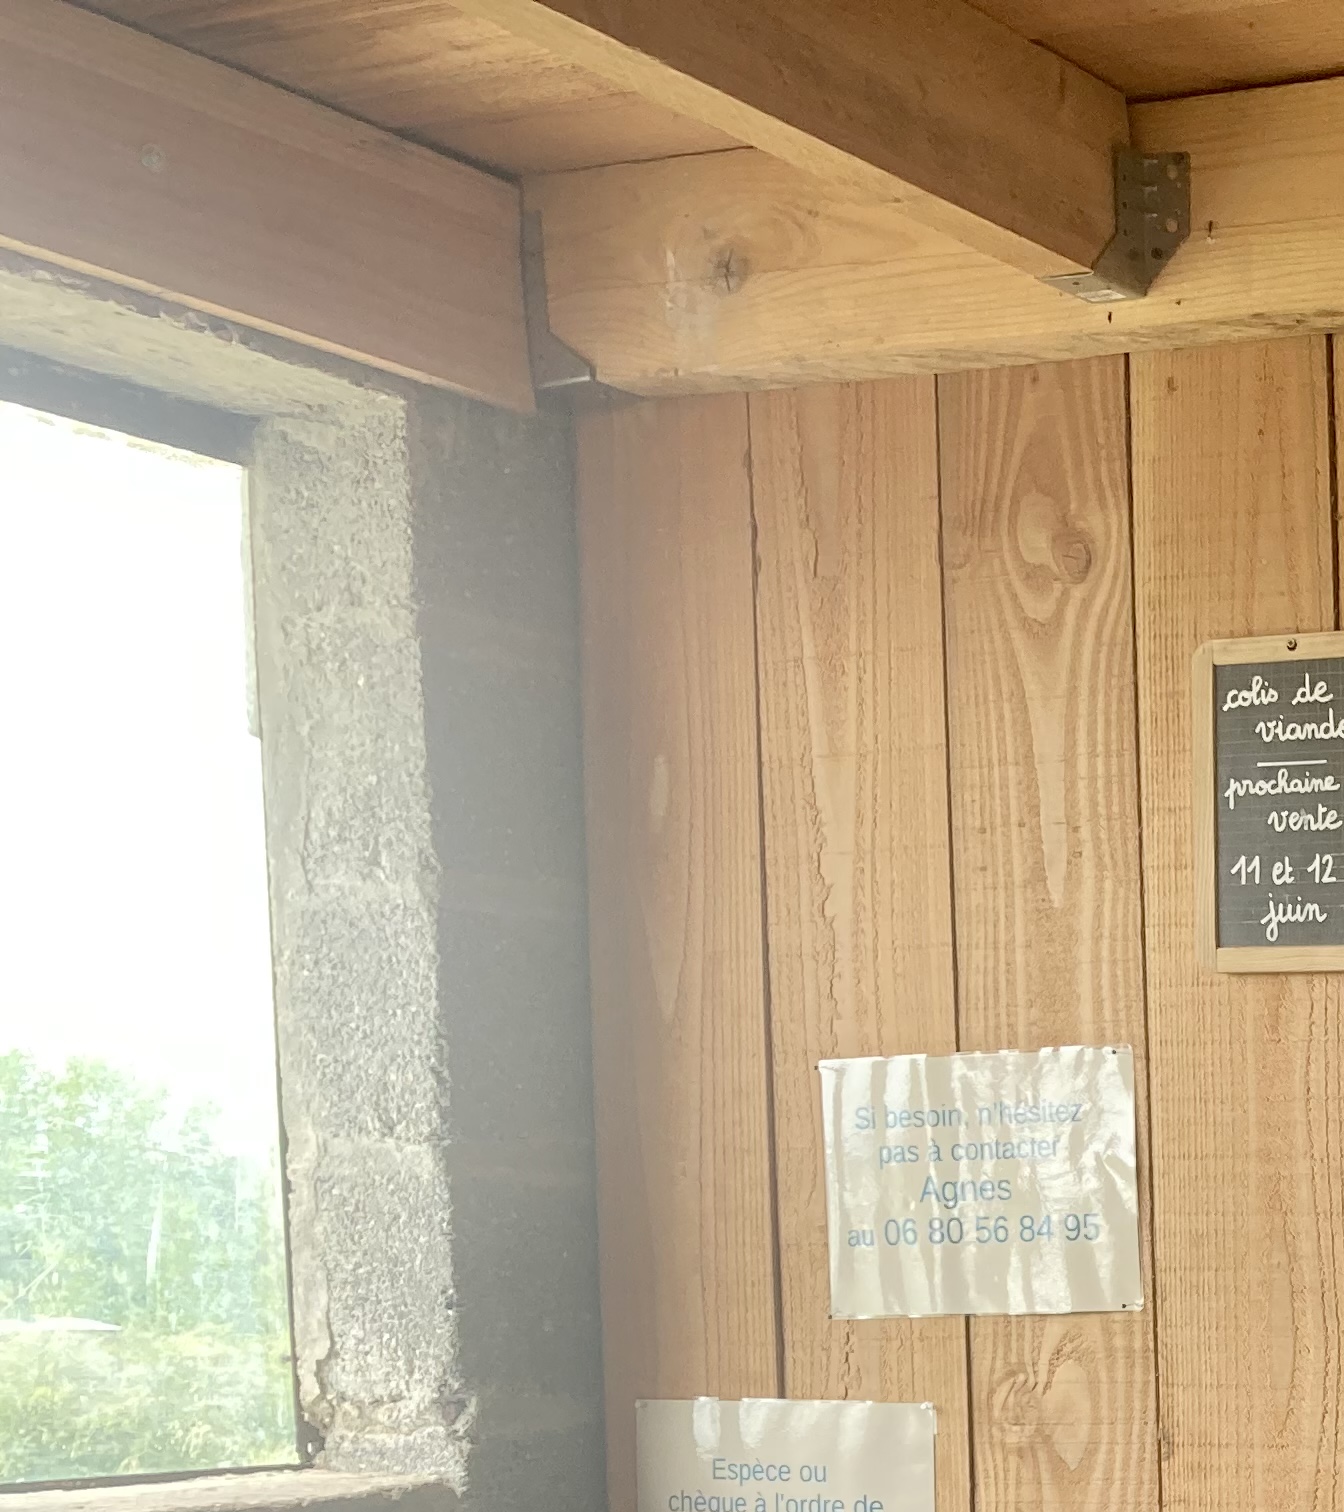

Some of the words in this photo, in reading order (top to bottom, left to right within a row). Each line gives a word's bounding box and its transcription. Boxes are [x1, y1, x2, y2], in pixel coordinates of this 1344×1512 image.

[1222, 675, 1279, 711] colis
[1292, 673, 1333, 705] de
[1224, 768, 1340, 809] prochaine
[1268, 804, 1343, 832] vente
[1231, 855, 1261, 884] 11
[1272, 856, 1294, 885] et
[1307, 853, 1336, 884] 12
[1261, 893, 1327, 941] juin
[855, 1106, 876, 1130] Si
[884, 1104, 969, 1131] besoin,
[880, 1144, 918, 1169] pas
[929, 1139, 943, 1163] à
[951, 1138, 1059, 1162] contacter
[848, 1228, 874, 1247] au
[885, 1219, 917, 1246] 06
[928, 1218, 963, 1244] 80
[976, 1216, 1008, 1243] 56
[1019, 1215, 1051, 1242] 84
[1064, 1213, 1100, 1241] 95
[712, 1458, 790, 1486] Espèce
[800, 1464, 827, 1482] ou
